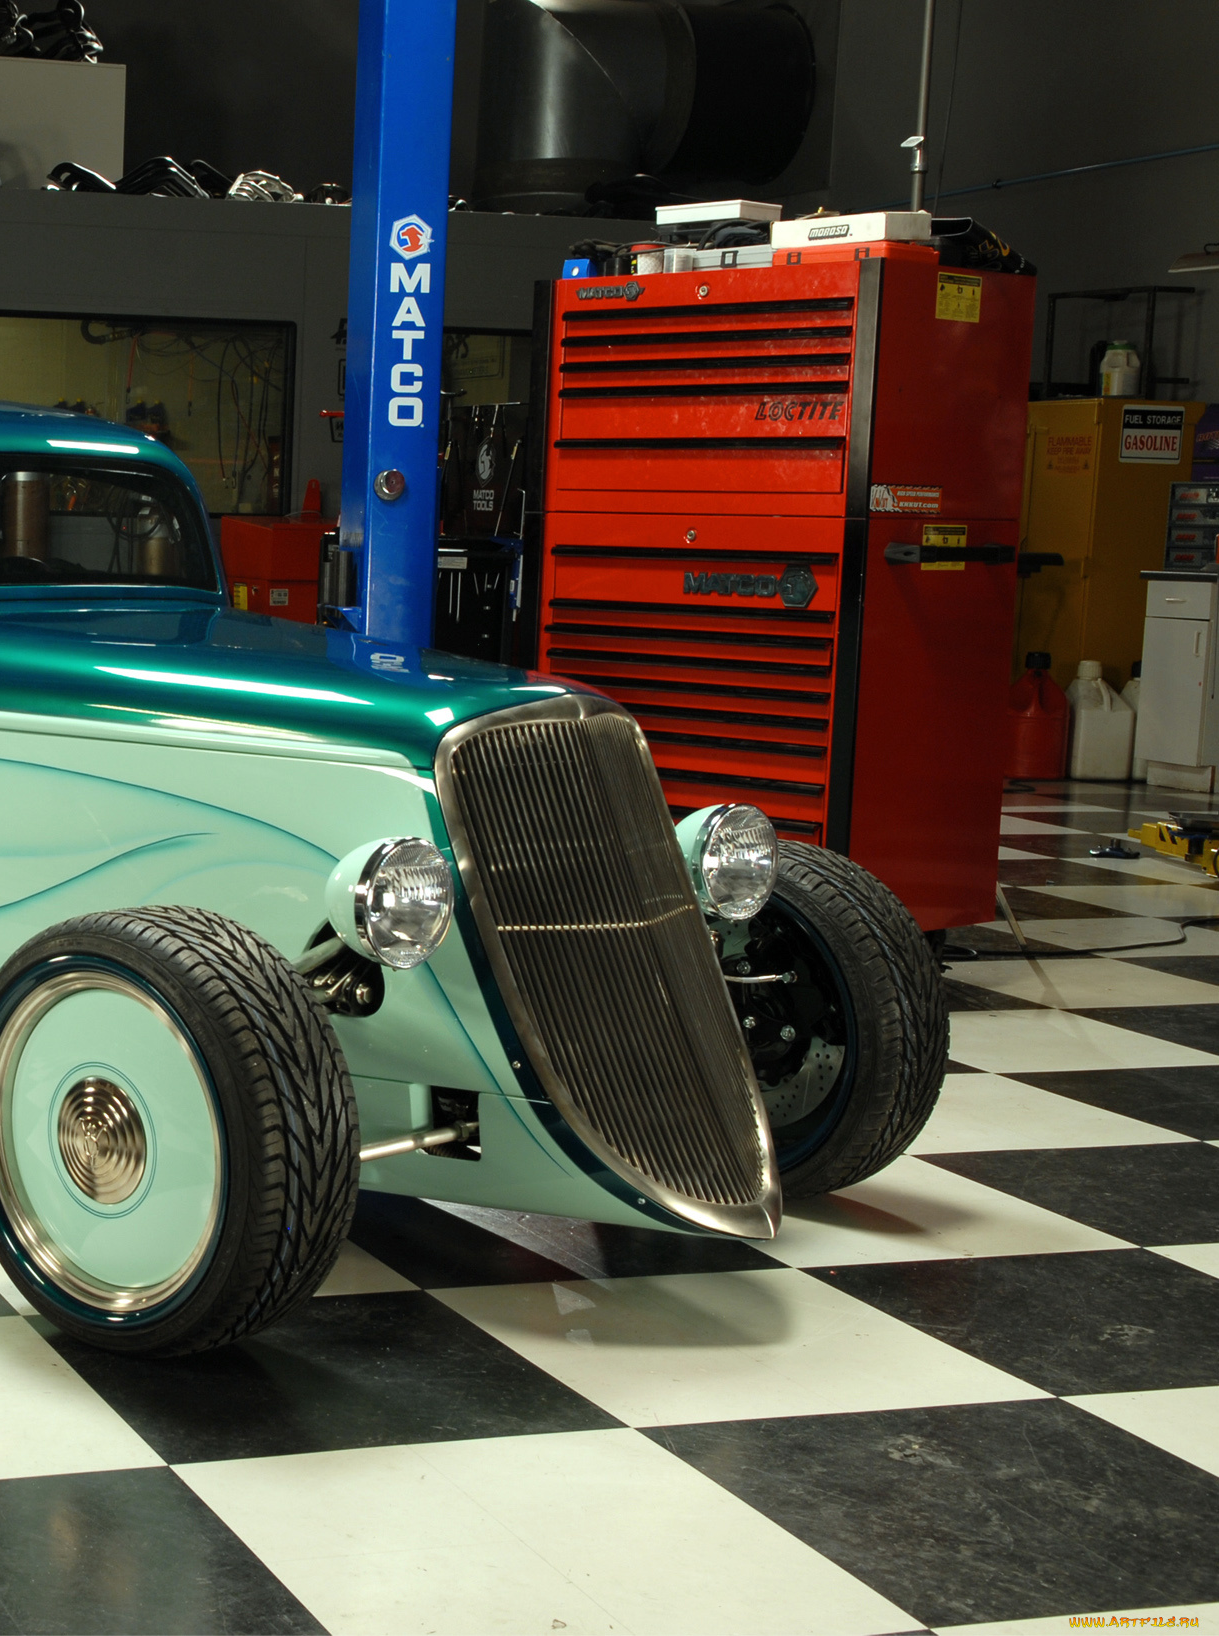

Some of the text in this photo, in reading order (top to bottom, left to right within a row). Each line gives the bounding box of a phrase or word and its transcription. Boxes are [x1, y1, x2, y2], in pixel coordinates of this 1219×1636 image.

[808, 225, 849, 240] MOROSO
[577, 286, 624, 300] MATCO
[387, 262, 432, 428] MATCO
[755, 401, 844, 421] LOCTITE
[1124, 414, 1182, 426] FUEL STORAGE
[1047, 436, 1092, 447] FLAMMABLE
[1124, 435, 1178, 452] GASOLINE
[473, 489, 494, 500] MATCO
[473, 500, 494, 511] TOOLS
[683, 572, 779, 597] MATCO
